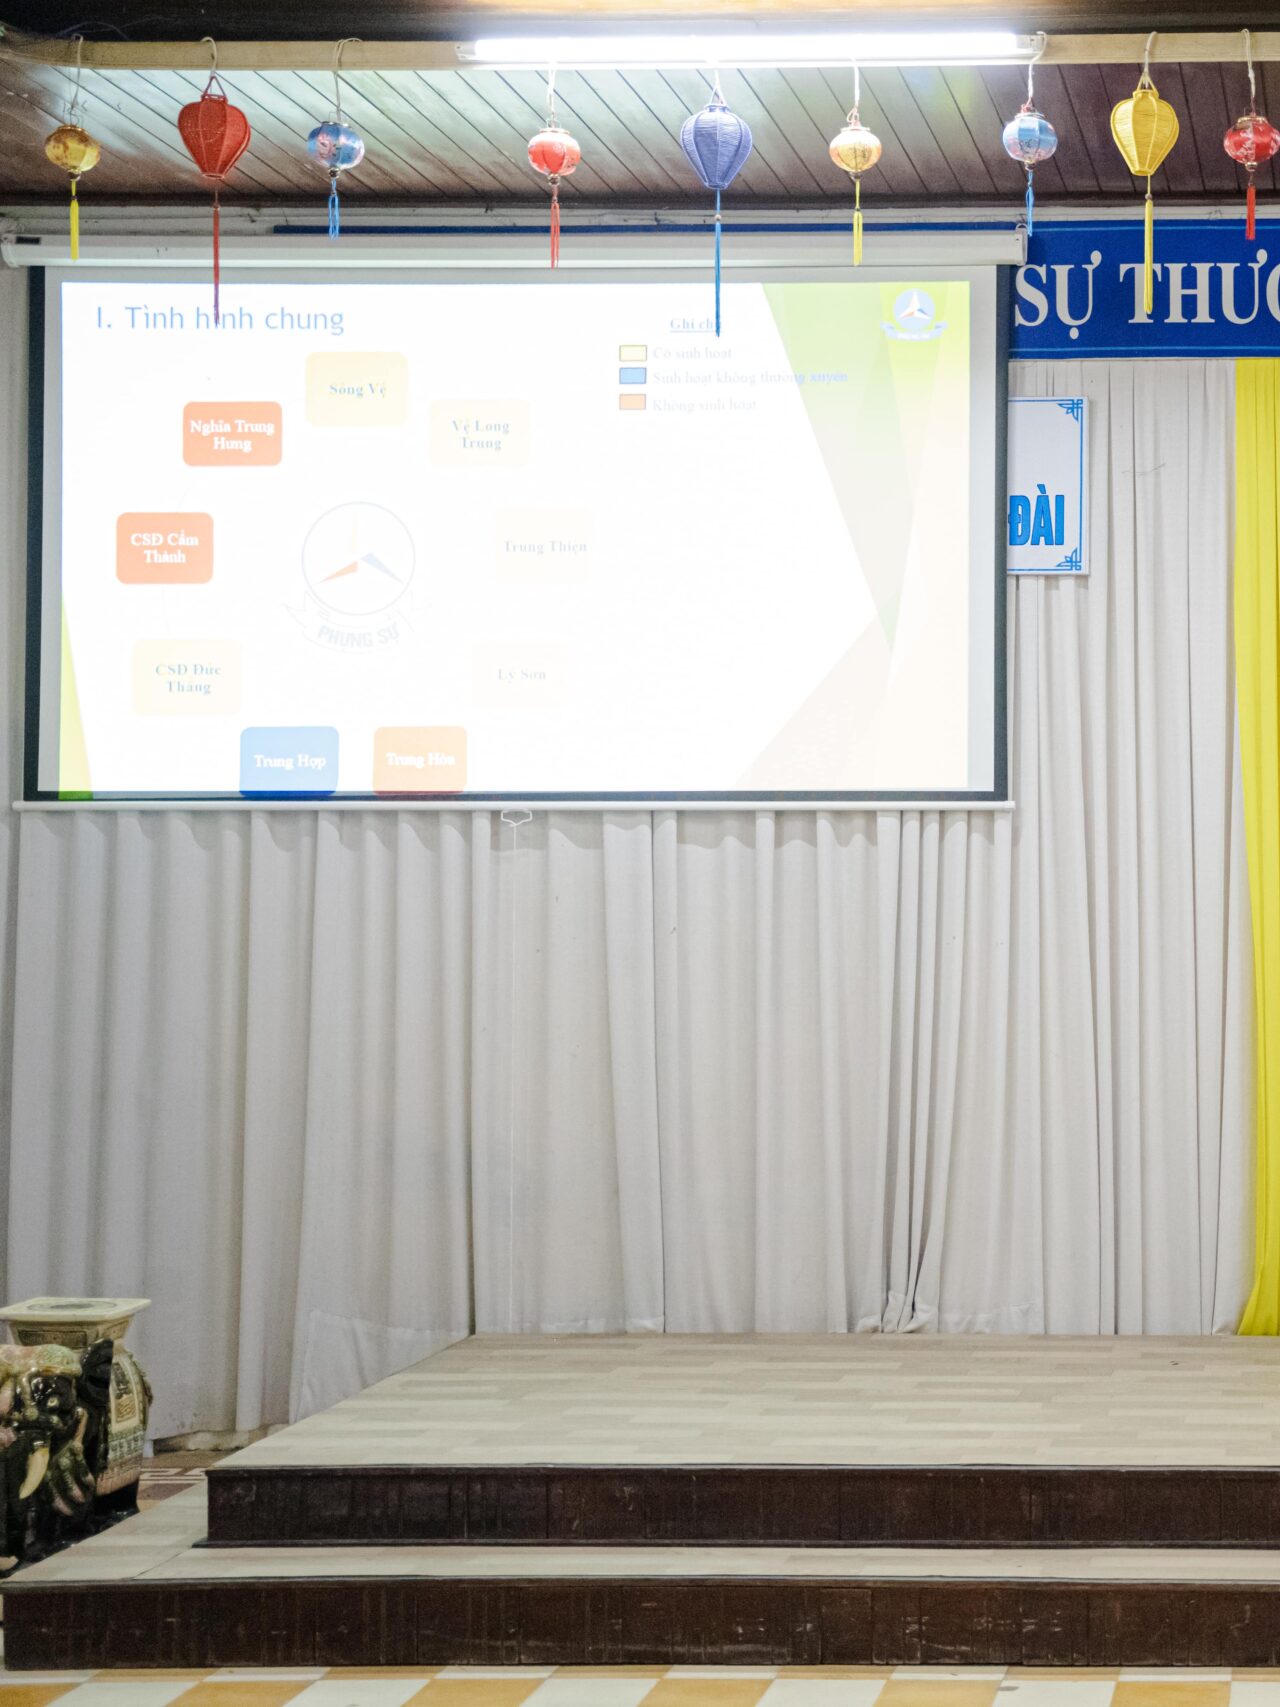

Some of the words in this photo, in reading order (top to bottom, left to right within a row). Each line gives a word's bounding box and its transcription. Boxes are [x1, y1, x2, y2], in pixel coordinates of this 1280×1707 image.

[1014, 250, 1102, 339] SỰ
[124, 303, 184, 330] Tình
[264, 306, 345, 337] chung
[669, 318, 696, 330] Ghi
[675, 346, 701, 359] sinh
[653, 371, 681, 385] Sinh
[234, 419, 276, 436] Trung
[474, 419, 511, 435] Long
[461, 436, 503, 452] Trung
[1007, 483, 1065, 546] ĐÀI
[504, 539, 545, 557] Trung
[254, 754, 295, 770] Trung
[386, 752, 425, 769] Trung
